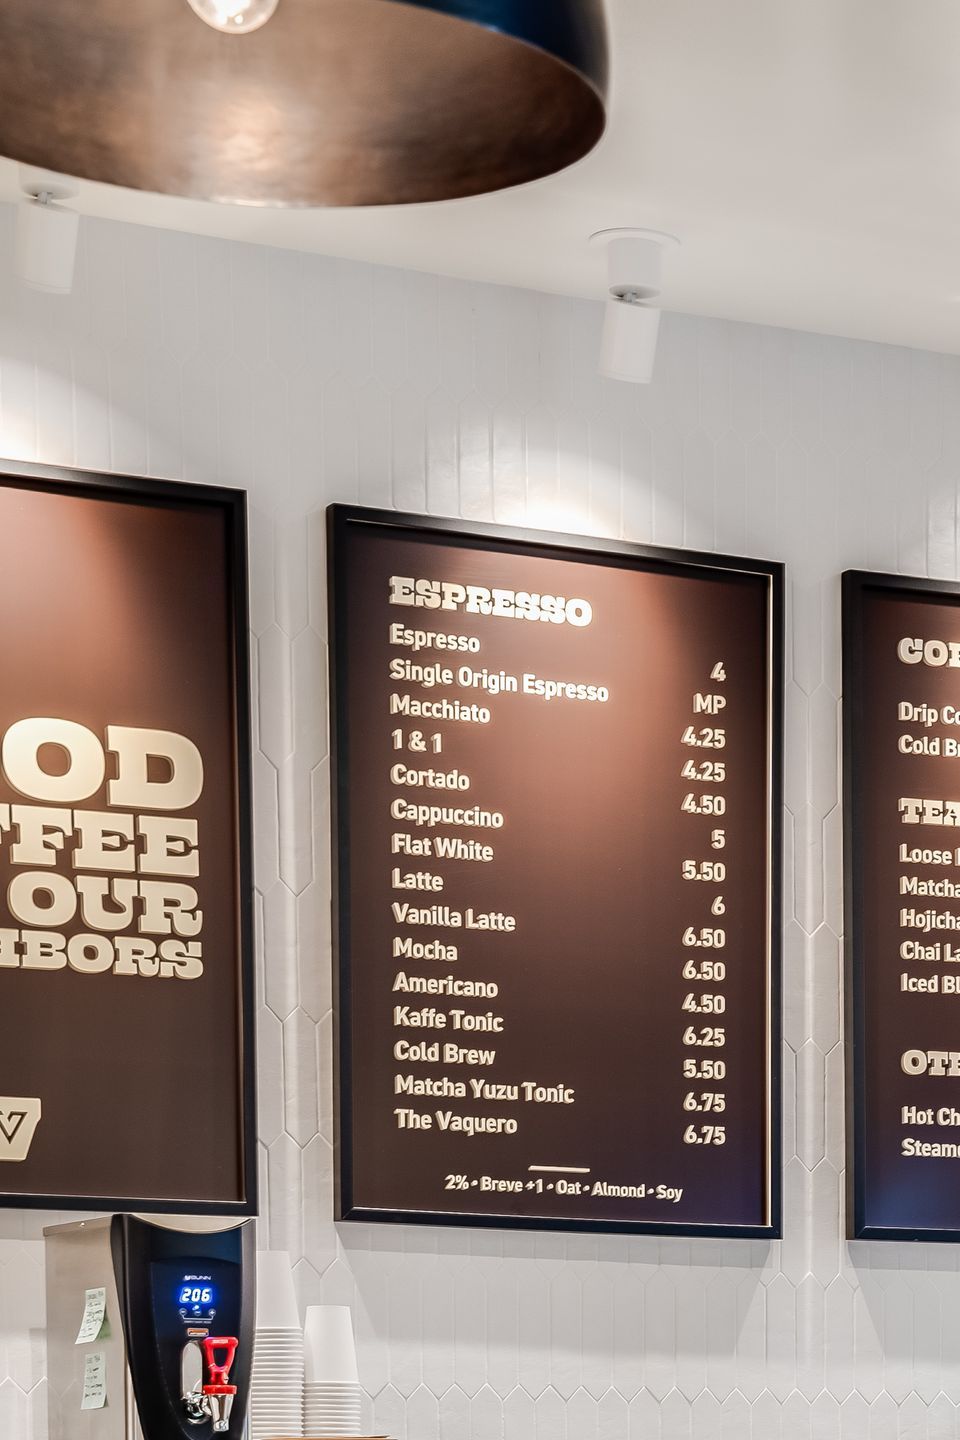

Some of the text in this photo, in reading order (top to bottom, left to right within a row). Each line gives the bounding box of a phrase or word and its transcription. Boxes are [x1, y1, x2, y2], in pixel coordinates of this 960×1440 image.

[389, 576, 593, 627] ESPRESSO
[389, 623, 480, 653] Espresso
[389, 659, 609, 702] Single Origin Espresso
[710, 662, 726, 681] 4
[389, 694, 491, 723] Macchiato
[693, 695, 726, 715] MP
[898, 701, 939, 727] Drip
[391, 729, 443, 753] 1 & 1
[681, 726, 726, 748] 4.25
[898, 735, 941, 757] Cold
[390, 764, 470, 791] Cortado
[681, 760, 726, 782] 4.25
[390, 798, 504, 828] Cappuccino
[681, 794, 726, 816] 4.50
[0, 803, 200, 878] FEE
[391, 833, 494, 862] Flat White
[711, 830, 726, 849] 5
[899, 844, 952, 866] Loose
[391, 868, 444, 892] Latte
[682, 860, 726, 882] 5.50
[7, 871, 203, 937] OUR
[710, 896, 726, 916] 6
[391, 903, 516, 932] Vanilla Latte
[682, 927, 726, 948] 6.50
[392, 937, 459, 961] Mocha
[900, 941, 941, 962] Chai
[682, 961, 726, 981] 6.50
[392, 972, 498, 998] Americano
[900, 973, 938, 993] Iced
[682, 994, 726, 1014] 4.50
[393, 1006, 504, 1033] Kaffe Tonic
[682, 1027, 726, 1047] 6.25
[393, 1040, 496, 1066] Cold Brew
[683, 1059, 726, 1080] 5.50
[394, 1074, 575, 1104] Matcha Yuzu Tonic
[683, 1093, 726, 1113] 6.75
[394, 1108, 518, 1136] The Vaquero
[901, 1106, 934, 1126] Hot
[683, 1125, 726, 1145] 6.75
[444, 1174, 683, 1203] 2% Breve +1 Oat Almond Soy
[181, 1288, 211, 1302] 206
